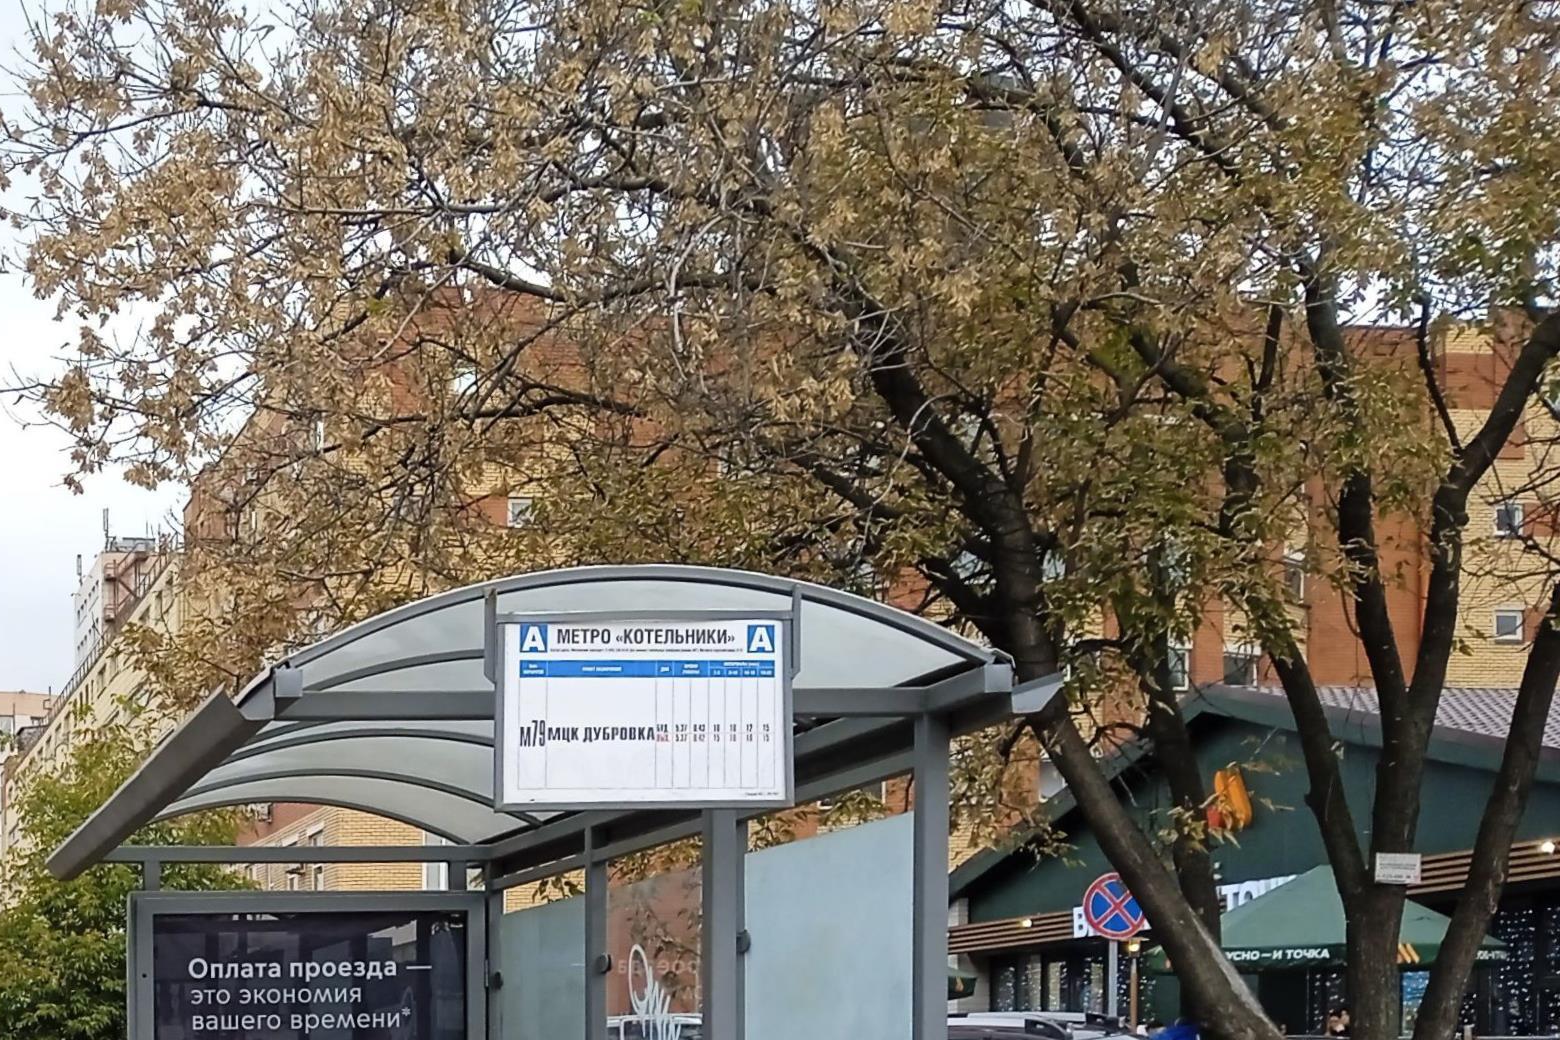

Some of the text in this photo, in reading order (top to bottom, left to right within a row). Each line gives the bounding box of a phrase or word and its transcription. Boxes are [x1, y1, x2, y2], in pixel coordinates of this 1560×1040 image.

[557, 628, 611, 644] МЕТРО
[616, 628, 735, 645] «КОТЕЛЬНИКИ»
[519, 719, 655, 747] М79 МЦК ДУБРОВКА
[1285, 948, 1330, 960] ТОЧКА
[188, 958, 281, 979] Оплата
[290, 960, 397, 982] проезда
[190, 986, 361, 1005] это экономия
[192, 1013, 281, 1031] вашего
